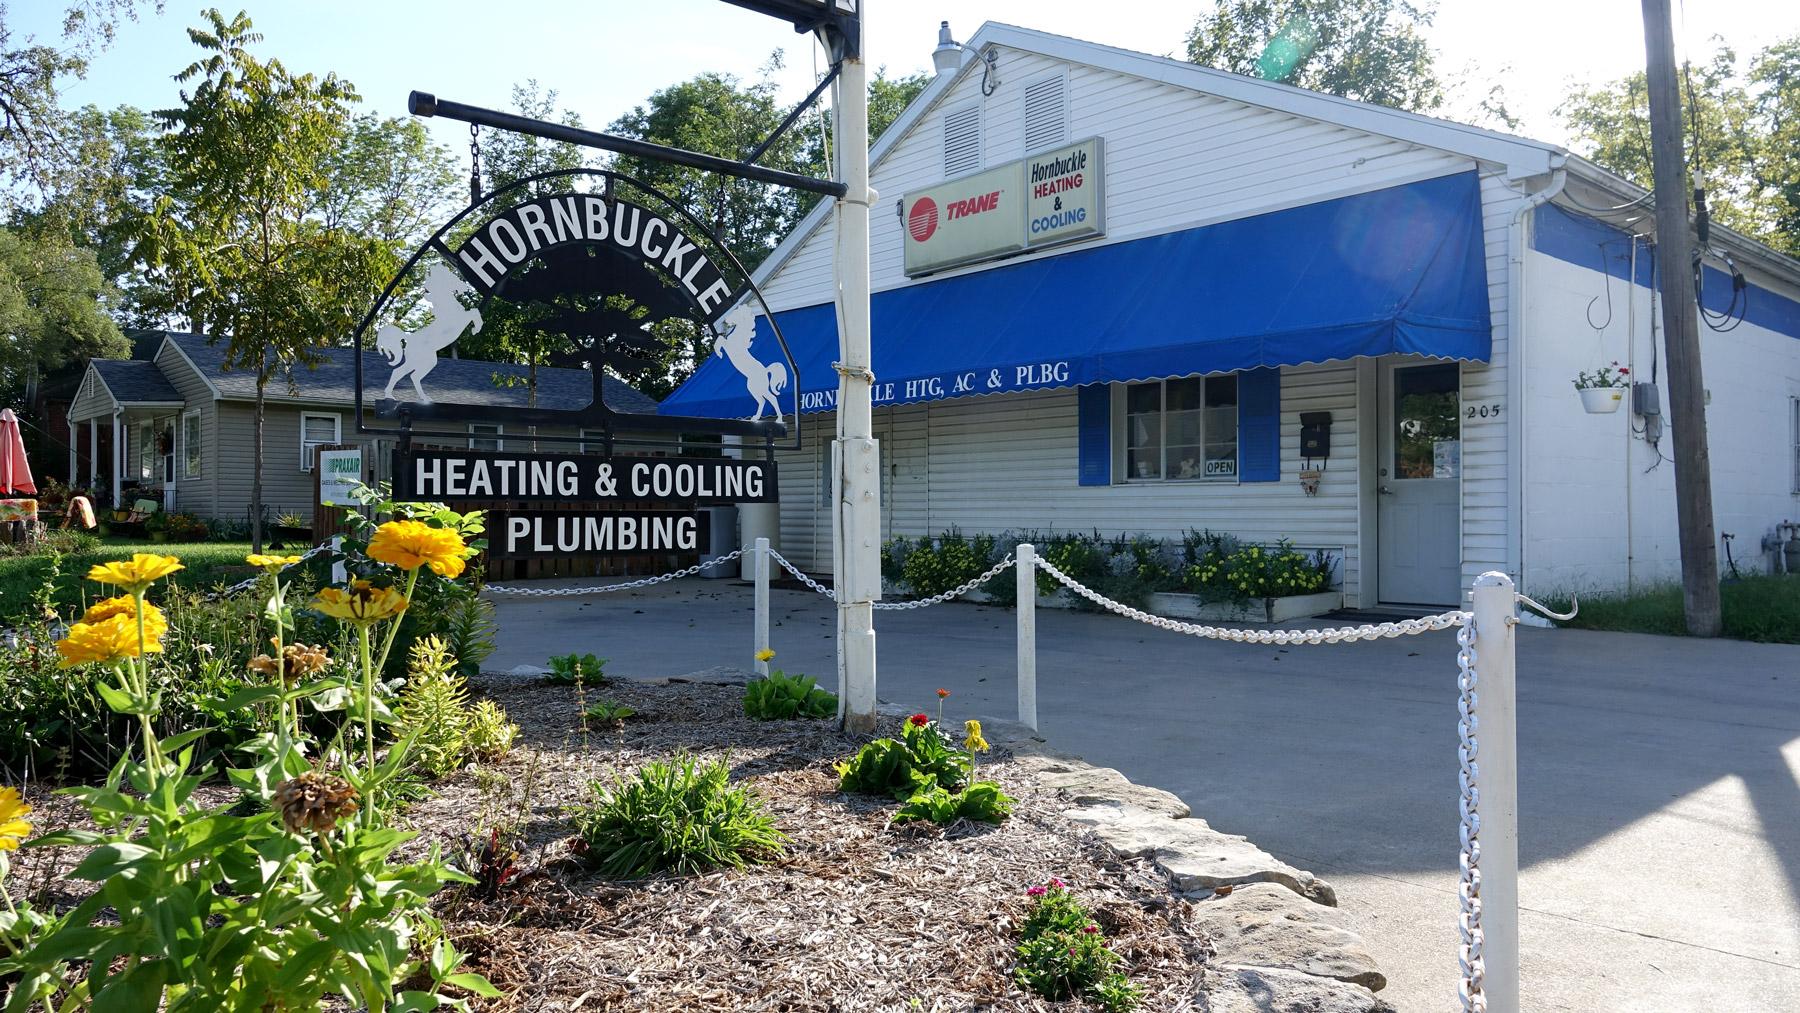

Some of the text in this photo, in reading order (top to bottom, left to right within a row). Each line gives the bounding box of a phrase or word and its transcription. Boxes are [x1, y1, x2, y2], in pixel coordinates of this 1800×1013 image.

[1031, 150, 1087, 184] Hornbuckle
[1034, 173, 1083, 199] HEATING
[947, 191, 1000, 220] TRANE
[1053, 196, 1063, 211] &
[1031, 207, 1087, 234] COOLING
[459, 197, 731, 315] HORNBUCKLE
[799, 361, 1070, 409] HORNLE HTG, AC & PLBG
[1467, 404, 1500, 419] 205
[335, 457, 360, 473] PRAXAIR
[416, 458, 764, 497] HEATING & COOLING
[1207, 461, 1233, 473] OPEN
[507, 515, 697, 552] PLUMBING
